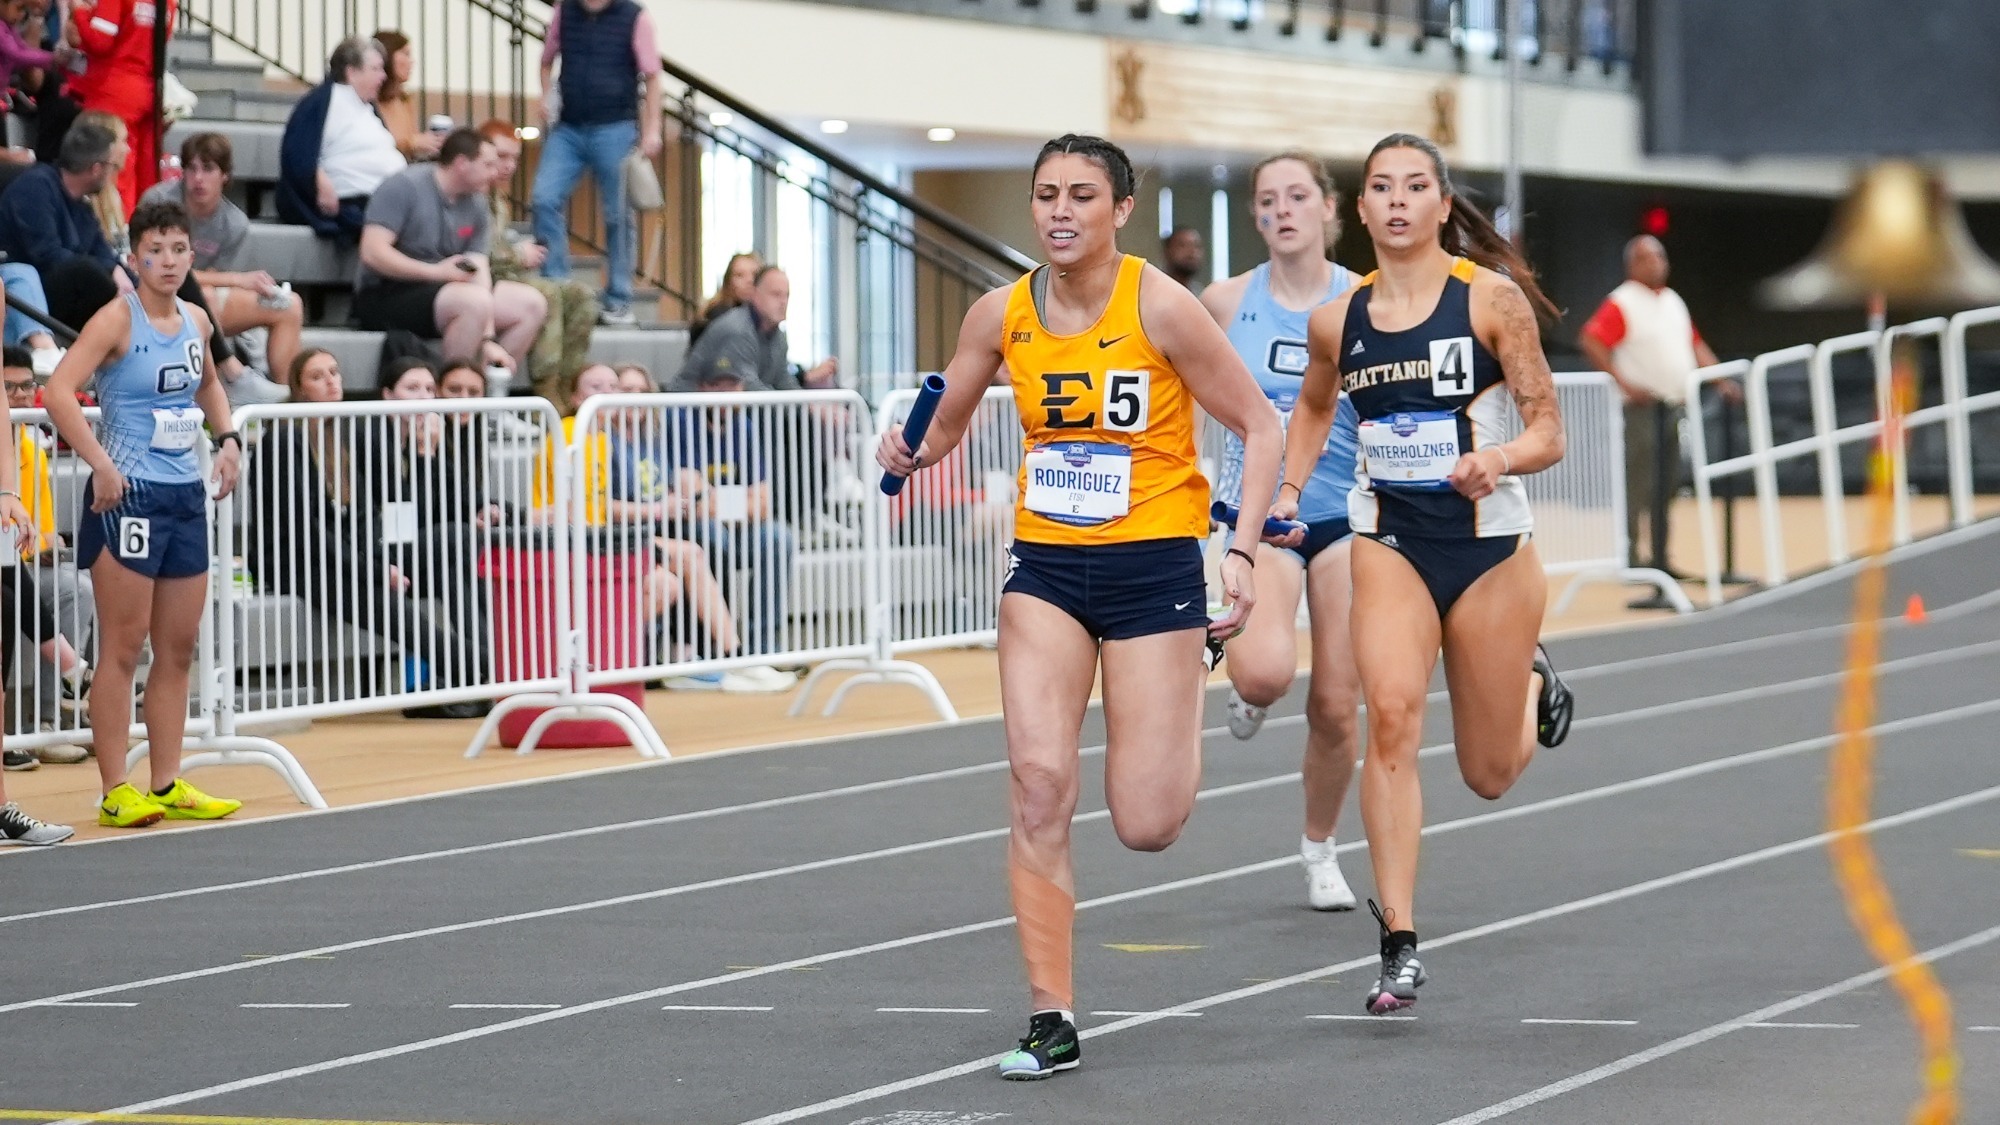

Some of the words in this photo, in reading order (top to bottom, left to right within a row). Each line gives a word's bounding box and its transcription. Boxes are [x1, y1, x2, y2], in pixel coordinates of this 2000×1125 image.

[188, 343, 201, 375] 6
[1438, 342, 1467, 390] 4
[1344, 360, 1432, 393] CHATTANO
[1040, 372, 1096, 429] E
[1108, 376, 1140, 427] 5
[163, 420, 198, 433] THIESSEN
[1365, 442, 1455, 459] UNTERHOLZNER
[1035, 468, 1121, 494] RODRIGUEZ
[1068, 492, 1086, 502] ETSU
[124, 521, 144, 553] 6
